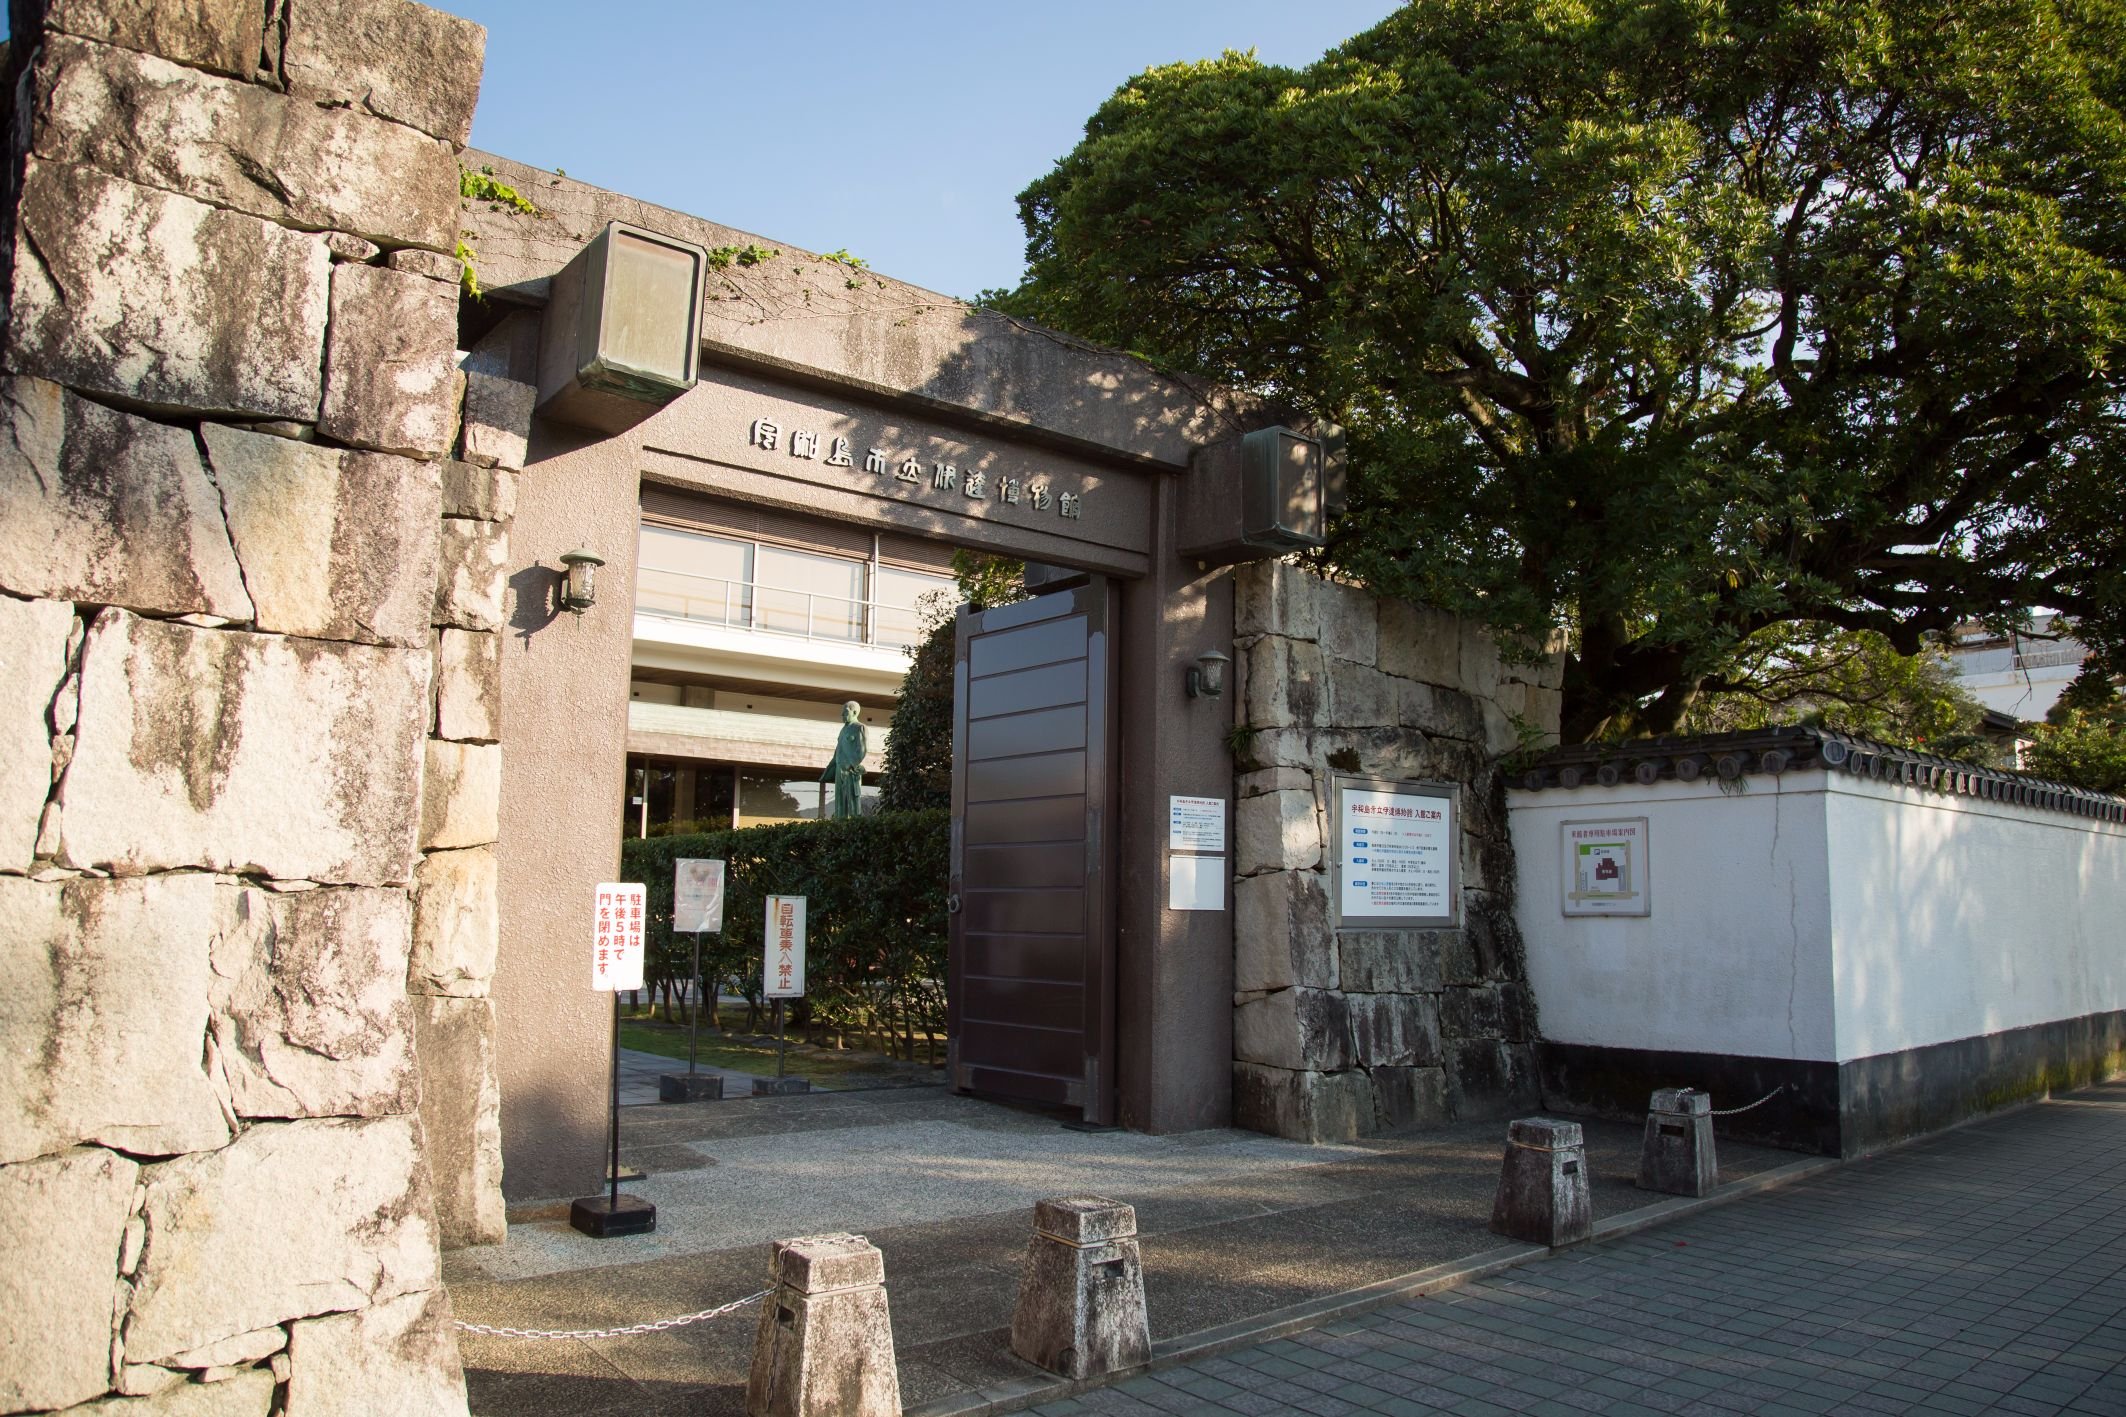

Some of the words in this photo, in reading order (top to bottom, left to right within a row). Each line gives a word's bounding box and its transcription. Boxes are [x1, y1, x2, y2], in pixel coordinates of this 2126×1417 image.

[629, 893, 642, 947] 駐車場は
[777, 903, 794, 989] 自転車乗入禁止
